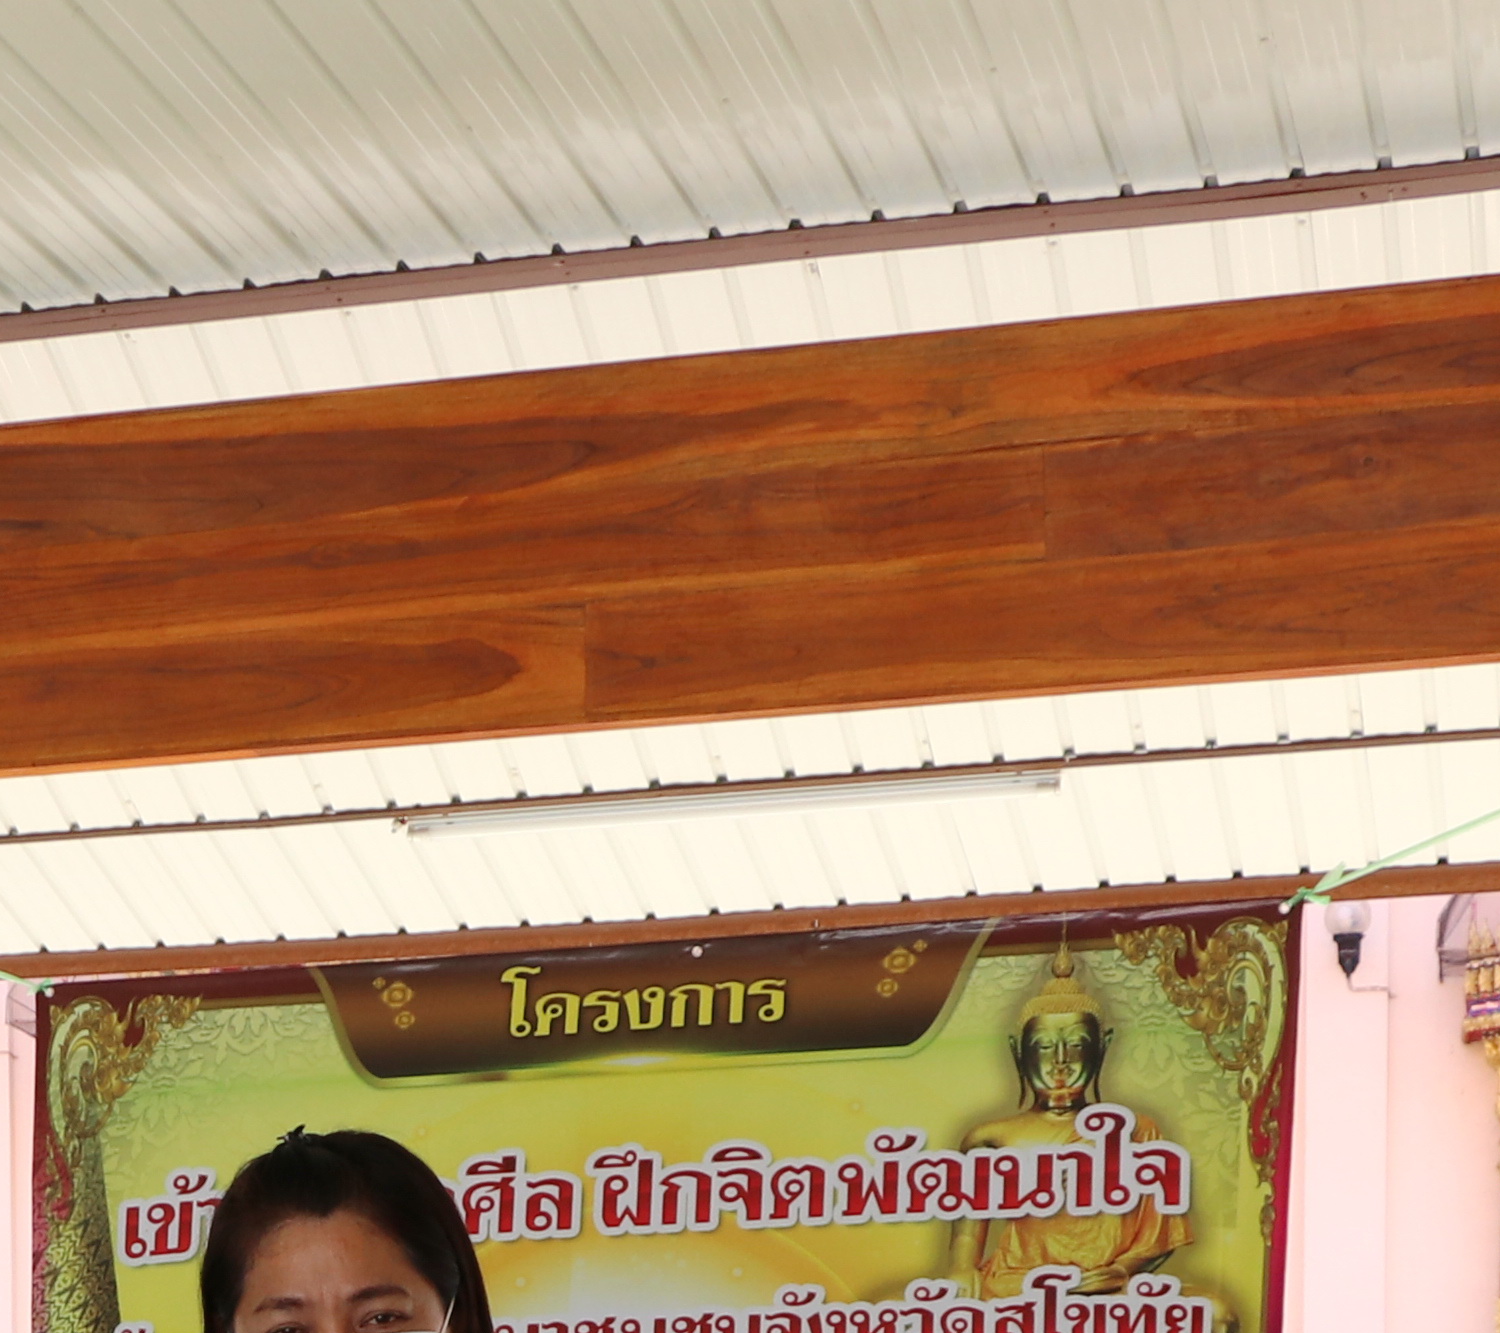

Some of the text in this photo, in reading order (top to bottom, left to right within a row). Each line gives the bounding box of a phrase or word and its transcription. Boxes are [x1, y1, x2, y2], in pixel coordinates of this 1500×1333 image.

[501, 965, 788, 1038] โครงการ
[445, 1154, 575, 1235] ศีล
[593, 1111, 1183, 1228] ฝึกจิตพัฒนาใจ
